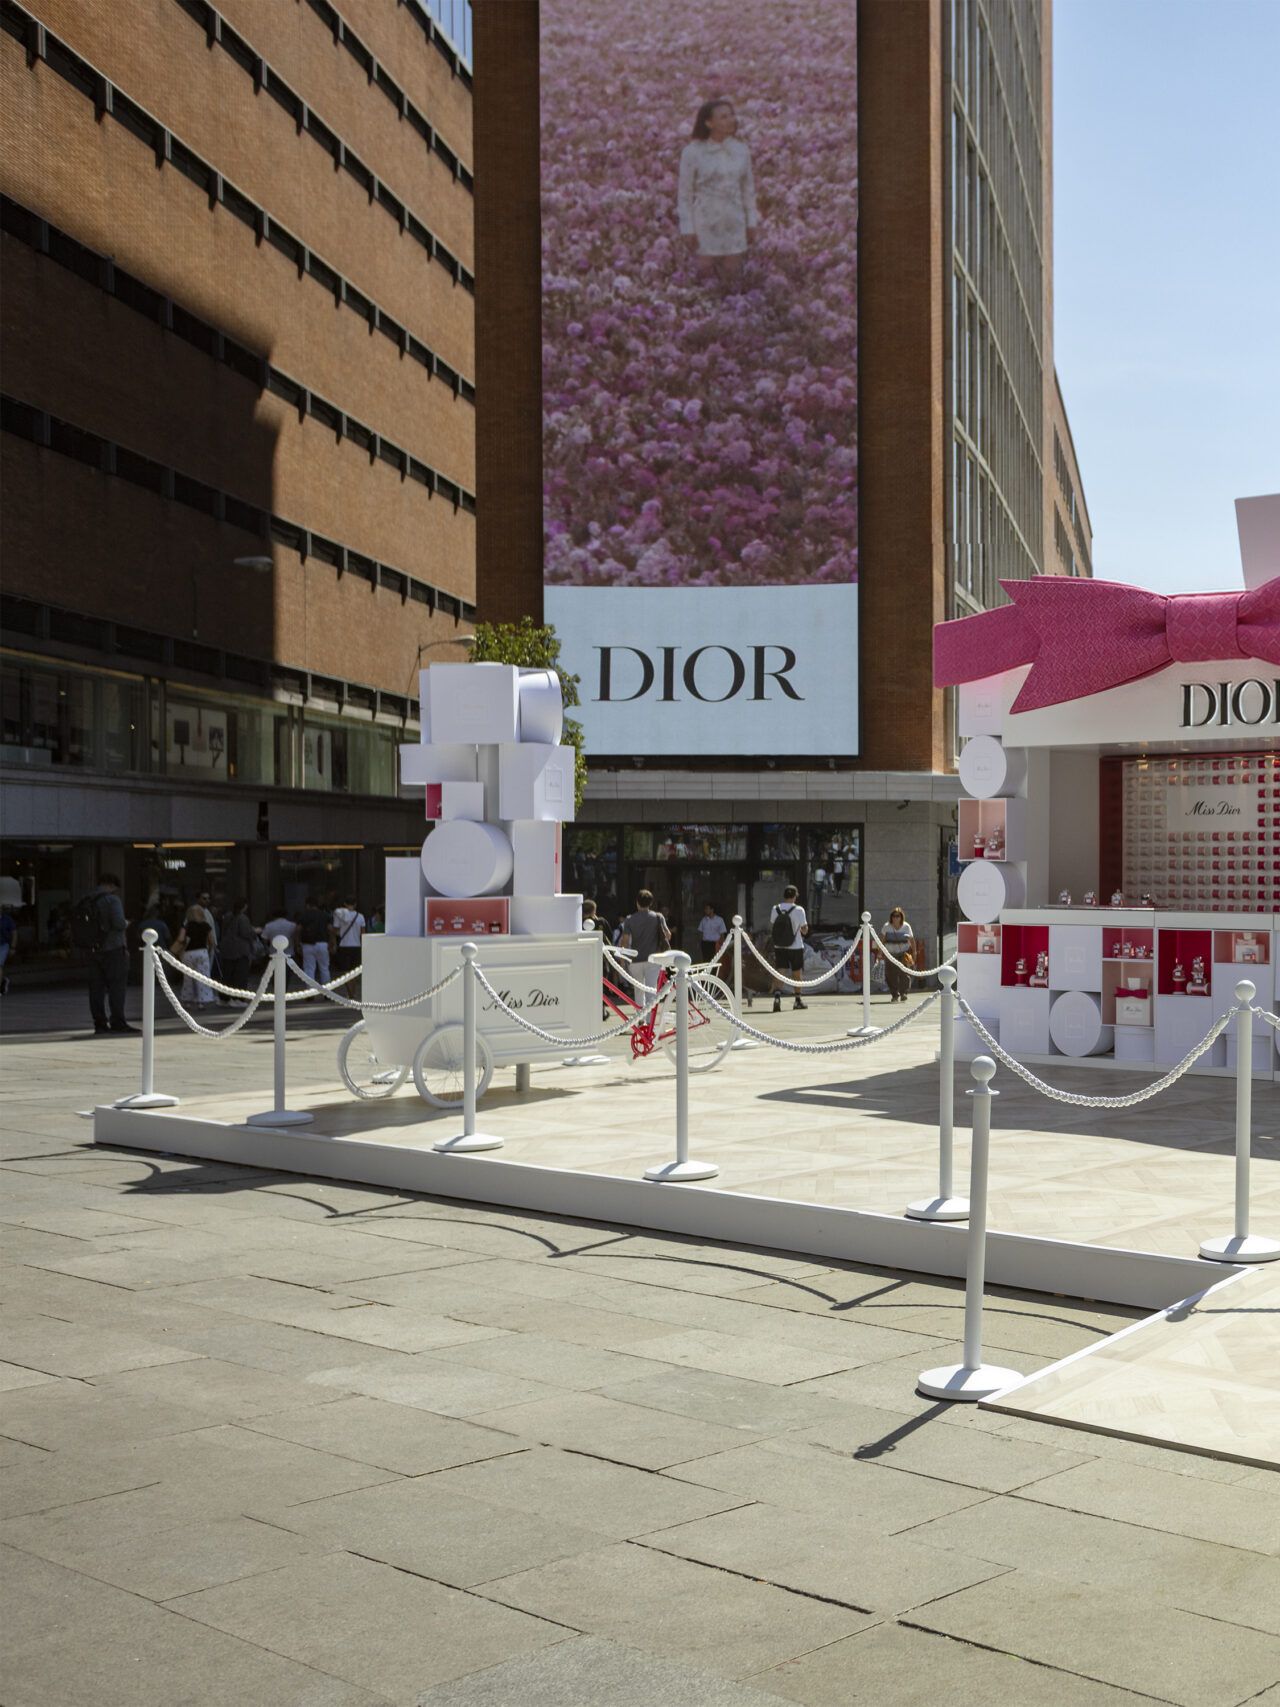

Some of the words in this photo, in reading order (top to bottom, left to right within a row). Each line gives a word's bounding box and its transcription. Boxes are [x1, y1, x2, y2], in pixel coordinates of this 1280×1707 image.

[591, 644, 806, 702] DIOR
[1185, 800, 1215, 816] Miss
[1216, 800, 1241, 816] Dior
[482, 990, 523, 1012] Miss
[526, 988, 560, 1008] Dior
